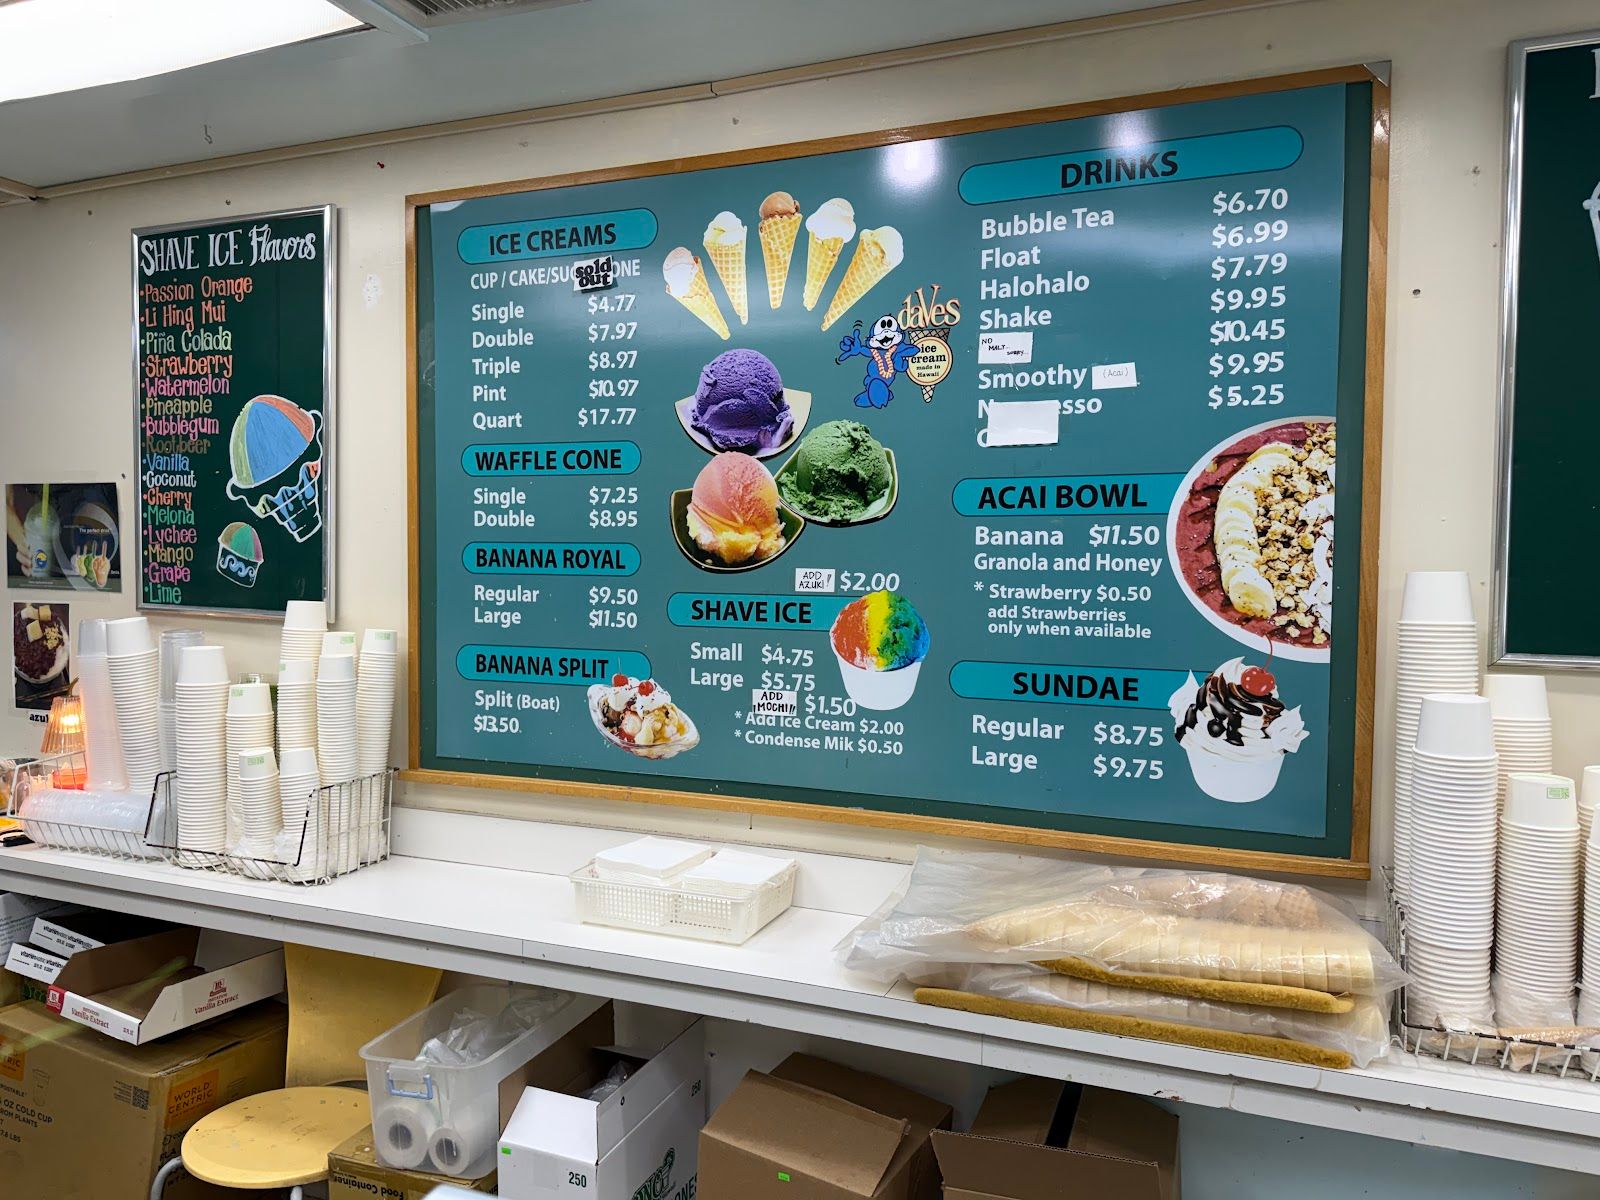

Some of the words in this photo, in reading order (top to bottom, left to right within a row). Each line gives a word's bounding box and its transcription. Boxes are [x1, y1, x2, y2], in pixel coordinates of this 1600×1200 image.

[1061, 150, 1179, 189] DRINKS
[981, 211, 1067, 240] Bubble
[1072, 207, 1115, 231] Tea
[1212, 188, 1289, 216] $6.70
[140, 235, 199, 276] SHAVE
[207, 229, 243, 267] ICE
[249, 224, 316, 266] Flavors
[489, 232, 522, 257] ICE
[526, 223, 617, 252] CREAMS
[981, 245, 1041, 270] Float
[1212, 219, 1289, 249] $6.99
[470, 272, 499, 290] CUP
[612, 259, 641, 278] ONE
[575, 257, 612, 279] sold
[980, 270, 1090, 300] Halohalo
[1211, 252, 1288, 281] $7.79
[145, 278, 194, 304] Passion
[201, 275, 253, 302] Orange
[578, 273, 611, 288] out
[145, 305, 157, 327] Li
[163, 304, 194, 333] Hing
[201, 300, 226, 325] Mui
[471, 301, 525, 324] Single
[587, 294, 637, 315] $4.77
[979, 305, 1052, 331] Shake
[1210, 285, 1287, 313] $9.95
[146, 331, 175, 354] Piña
[181, 326, 232, 352] Colada
[472, 328, 534, 349] Double
[588, 322, 638, 343] $7.97
[1209, 318, 1286, 346] $10.45
[911, 354, 947, 364] cream
[921, 344, 937, 353] ice
[145, 352, 233, 378] Strawberry
[472, 356, 521, 378] Triple
[588, 350, 638, 372] $8.97
[978, 364, 1087, 390] Smoothy
[1209, 351, 1285, 378] $9.95
[1103, 367, 1129, 378] (Acai)
[145, 374, 230, 397] Watermelon
[472, 384, 507, 402] Pint
[588, 379, 640, 399] $10.97
[1208, 384, 1285, 410] $5.25
[146, 395, 212, 418] Pineapple
[145, 415, 219, 441] Bubblegum
[472, 411, 523, 431] Quart
[578, 407, 637, 427] $17.77
[146, 453, 190, 472] Vanilla
[475, 450, 557, 471] WAFFLE
[562, 449, 622, 470] CONE
[146, 470, 197, 488] Coconut
[147, 487, 192, 510] Cherry
[473, 487, 527, 509] Single
[589, 486, 638, 505] $7.25
[977, 485, 1046, 510] ACAI
[1055, 483, 1148, 509] BOWL
[147, 505, 195, 525] Melona
[473, 510, 535, 527] Double
[589, 509, 638, 529] $8.95
[148, 525, 197, 548] Lychee
[975, 525, 1064, 546] Banana
[1089, 524, 1160, 547] $11.50
[148, 543, 193, 568] Mango
[475, 548, 557, 569] BANANA
[563, 549, 626, 570] ROYAL
[974, 552, 1049, 571] Granola
[1053, 552, 1090, 571] and
[1096, 553, 1162, 576] Honey
[148, 562, 190, 585] Grape
[802, 571, 822, 580] ADD
[840, 570, 900, 592] $2.00
[149, 583, 181, 604] Lime
[474, 585, 540, 607] Regular
[589, 586, 638, 606] $9.50
[989, 583, 1092, 604] Strawberry
[1096, 585, 1152, 603] $0.50
[474, 607, 522, 629] Large
[589, 609, 638, 629] $11.50
[691, 600, 768, 623] SHAVE
[775, 601, 812, 624] ICE
[987, 605, 1018, 619] add
[1021, 605, 1127, 621] Strawberries
[987, 621, 1021, 637] only
[1026, 622, 1070, 636] when
[1074, 622, 1152, 639] available
[475, 653, 554, 677] BANANA
[558, 658, 609, 679] SPLIT
[690, 642, 743, 662] Small
[761, 643, 814, 667] $4.75
[690, 667, 744, 692] Large
[761, 670, 816, 693] $5.75
[1012, 671, 1140, 702] SUNDAE
[475, 690, 513, 711] Split
[516, 693, 560, 713] (Boat)
[761, 691, 783, 701] ADD
[804, 694, 857, 717] $1.50
[745, 711, 776, 727] Add
[780, 715, 801, 728] Ice
[804, 715, 855, 732] Cream
[859, 718, 904, 735] $2.00
[971, 714, 1065, 741] Regular
[1093, 721, 1164, 747] $8.75
[745, 730, 821, 749] Condense
[824, 736, 855, 752] Mik
[858, 738, 903, 755] $0.50
[971, 746, 1038, 773] Large
[1093, 753, 1164, 780] $9.75
[217, 993, 239, 1007] Extract
[90, 1013, 109, 1029] Extract
[168, 1089, 214, 1114] CENTRIC
[174, 1081, 210, 1102] WORLD
[14, 1113, 38, 1128] PLANTS
[16, 1103, 36, 1118] COLD
[37, 1112, 53, 1124] CUP
[334, 1174, 378, 1195] Container
[568, 1171, 587, 1188] 250
[380, 1186, 404, 1200] Food
